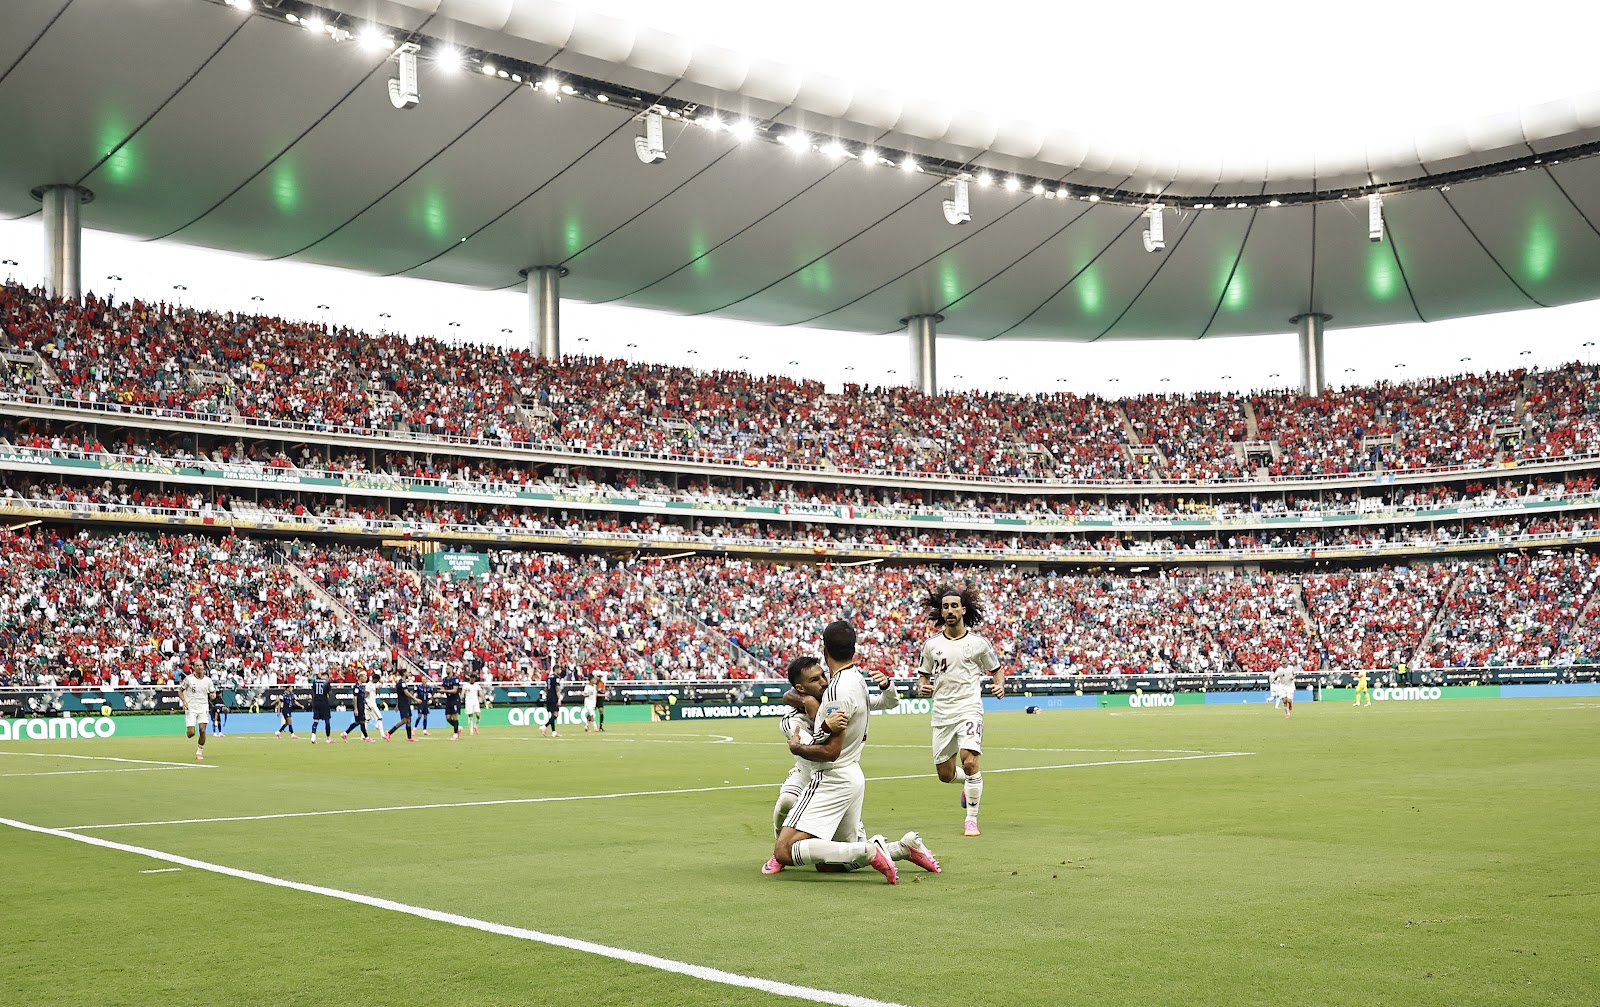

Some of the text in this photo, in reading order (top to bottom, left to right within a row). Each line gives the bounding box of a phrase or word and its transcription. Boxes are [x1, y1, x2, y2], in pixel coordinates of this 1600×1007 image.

[223, 471, 238, 479] FIFA
[238, 473, 262, 481] WORLD
[447, 487, 517, 498] GUADALAJARA
[1456, 503, 1525, 514] GUADALAJARA
[1129, 693, 1175, 708] aramco
[1372, 687, 1442, 701] aramco
[681, 707, 704, 718] FIFA
[703, 706, 740, 717] WORLD
[740, 705, 760, 718] CUP
[965, 720, 983, 739] 24
